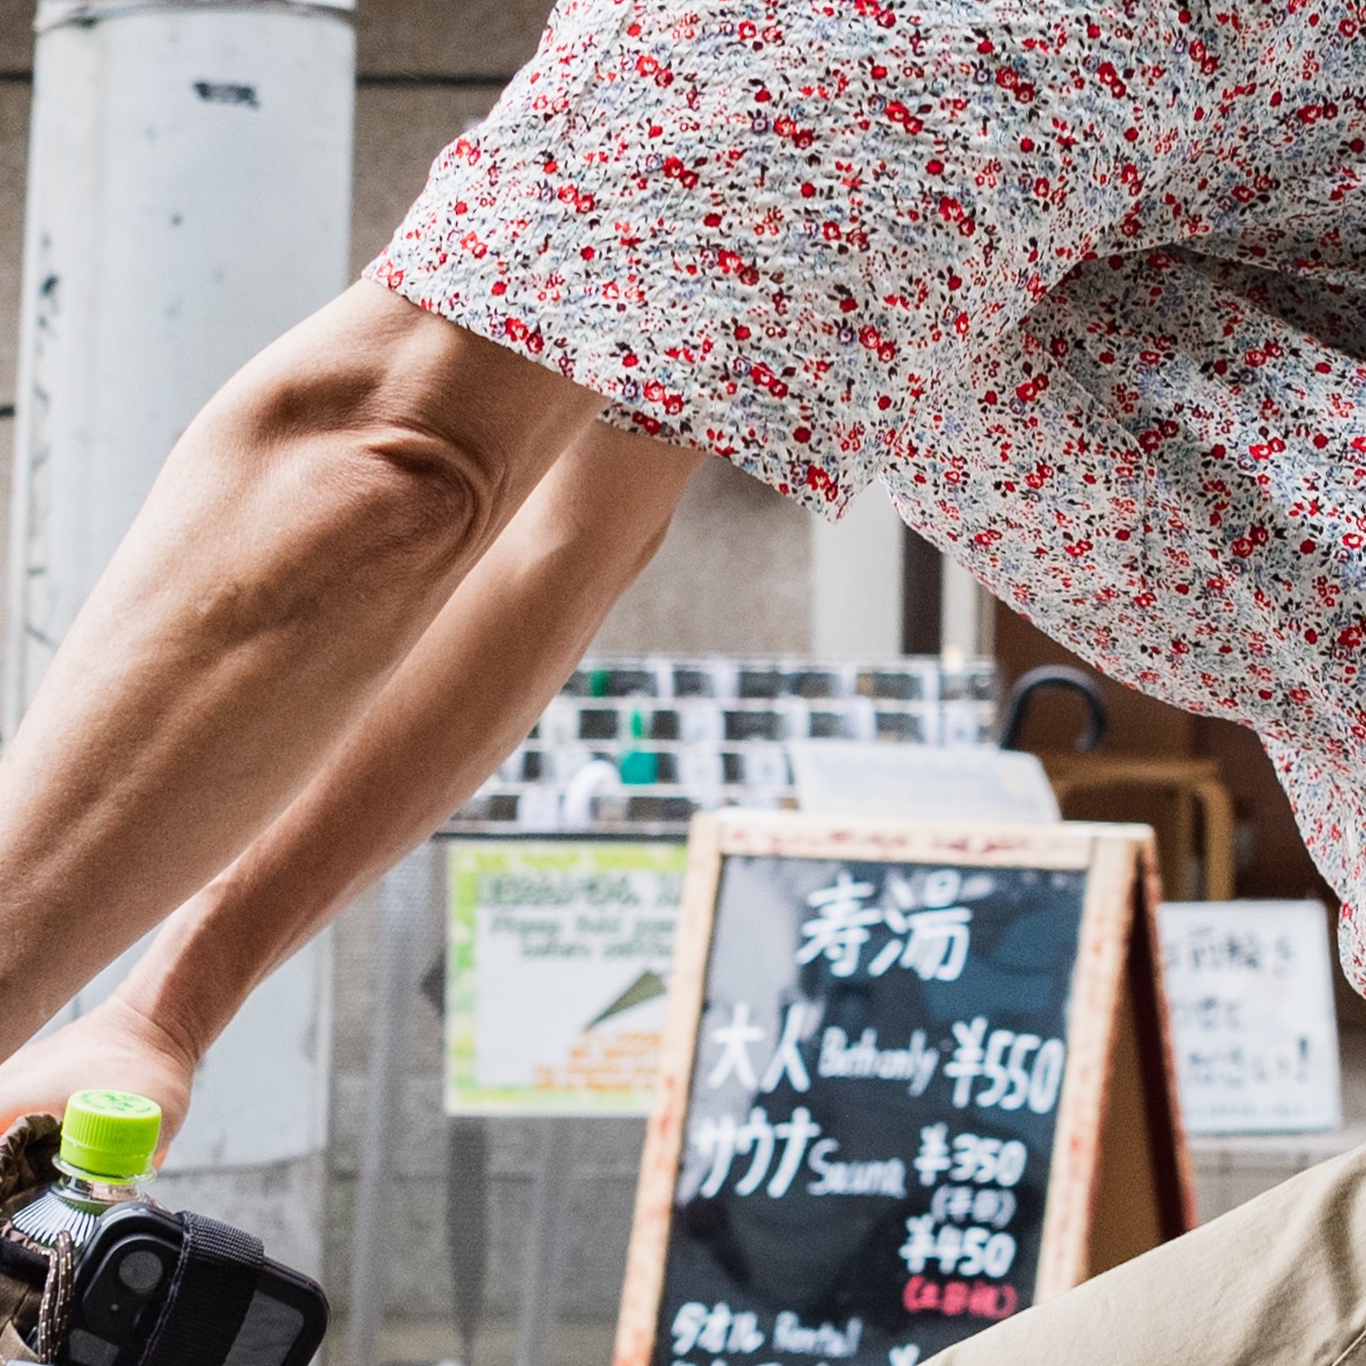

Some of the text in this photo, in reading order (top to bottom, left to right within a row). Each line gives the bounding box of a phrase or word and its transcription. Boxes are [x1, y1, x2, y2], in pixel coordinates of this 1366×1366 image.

[795, 869, 974, 983] 寿湯
[708, 1002, 811, 1093] 大人
[943, 1015, 1066, 1114] ¥550
[693, 1106, 821, 1199] サウナ
[913, 1120, 1028, 1187] ¥350
[898, 1213, 1017, 1278] ¥450
